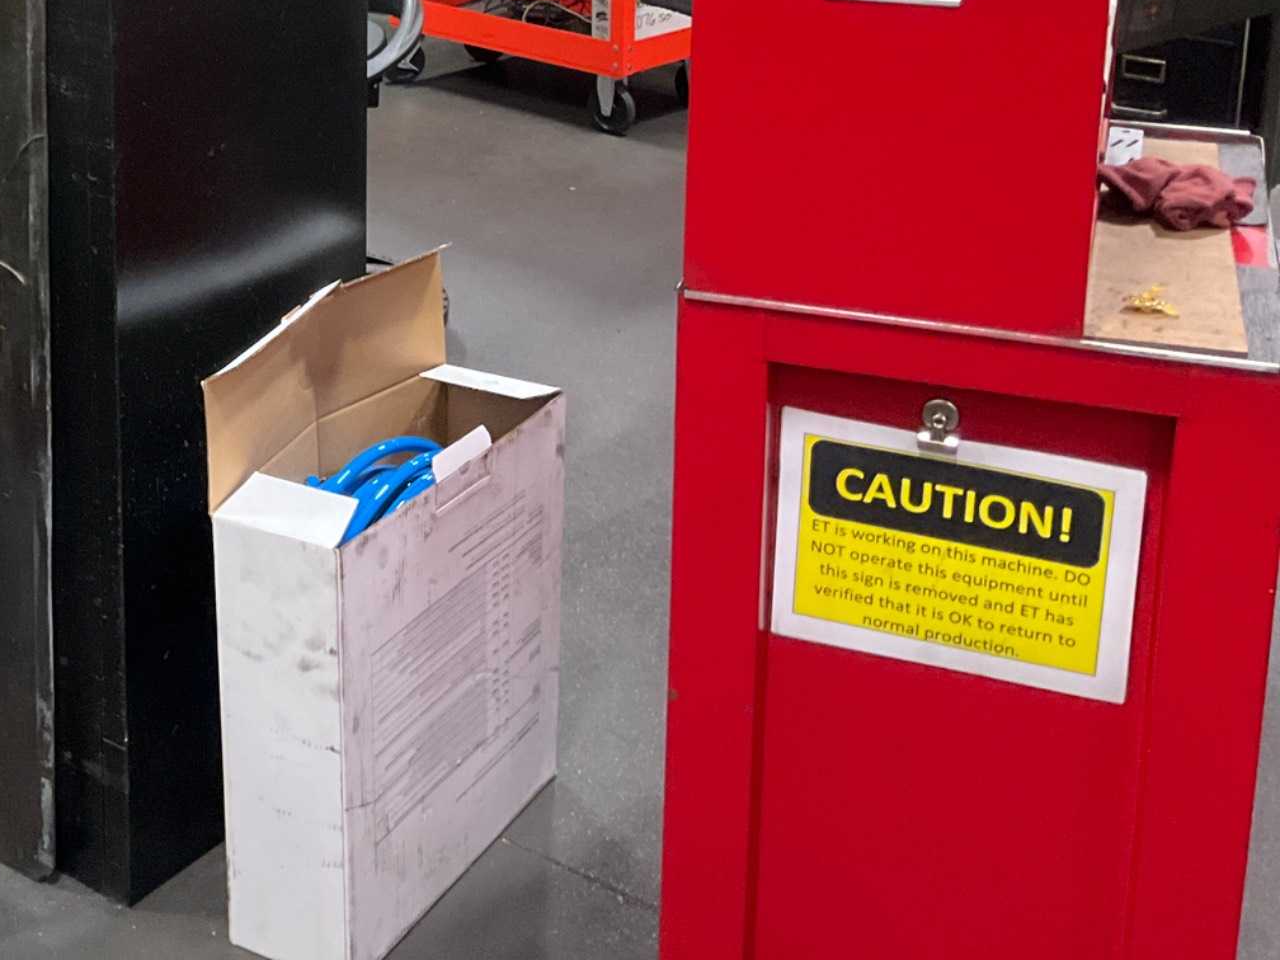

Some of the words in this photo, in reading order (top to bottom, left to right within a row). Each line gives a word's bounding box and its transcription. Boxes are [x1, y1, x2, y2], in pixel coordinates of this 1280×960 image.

[835, 467, 1073, 543] CAUTION!
[811, 540, 845, 557] NOT
[850, 550, 912, 572] operate
[919, 563, 947, 579] this
[952, 572, 1043, 599] equipment
[1049, 591, 1088, 607] until
[812, 519, 830, 533] ET
[835, 523, 846, 536] is
[852, 529, 916, 553] working
[920, 543, 941, 556] on
[947, 546, 976, 563] this
[982, 555, 1057, 580] machine.
[1064, 570, 1091, 586] DO
[814, 583, 874, 605] verified
[879, 595, 911, 614] that
[916, 605, 927, 618] it
[932, 607, 944, 620] is
[948, 611, 972, 626] OK
[977, 618, 994, 631] to
[999, 623, 1052, 644] return
[1059, 634, 1076, 648] to
[820, 563, 848, 579] this
[852, 571, 884, 588] sign
[889, 577, 901, 590] is
[905, 583, 979, 607] removed
[983, 599, 1015, 615] and
[1020, 604, 1040, 619] ET
[1045, 609, 1074, 626] has
[862, 615, 919, 636] normal
[924, 627, 1019, 658] production.
